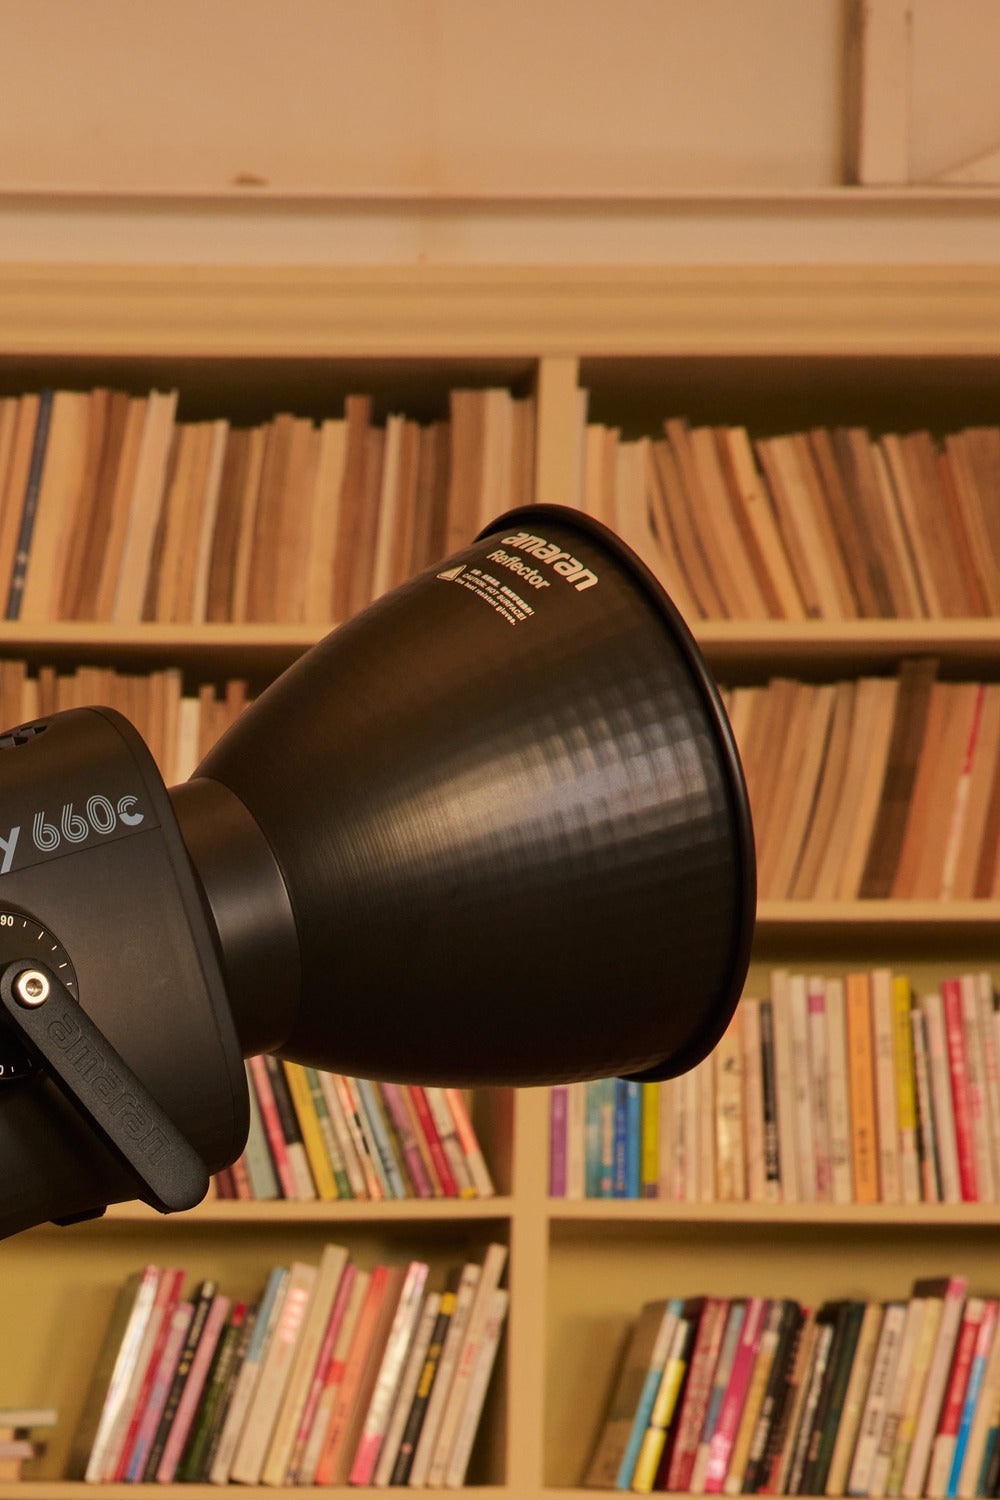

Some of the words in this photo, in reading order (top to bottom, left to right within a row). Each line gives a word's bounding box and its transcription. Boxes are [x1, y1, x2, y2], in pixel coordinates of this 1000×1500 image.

[486, 549, 551, 590] Reflector
[501, 532, 599, 592] amaran
[32, 794, 145, 852] 660c
[0, 915, 14, 927] 90
[47, 1013, 171, 1164] amaran
